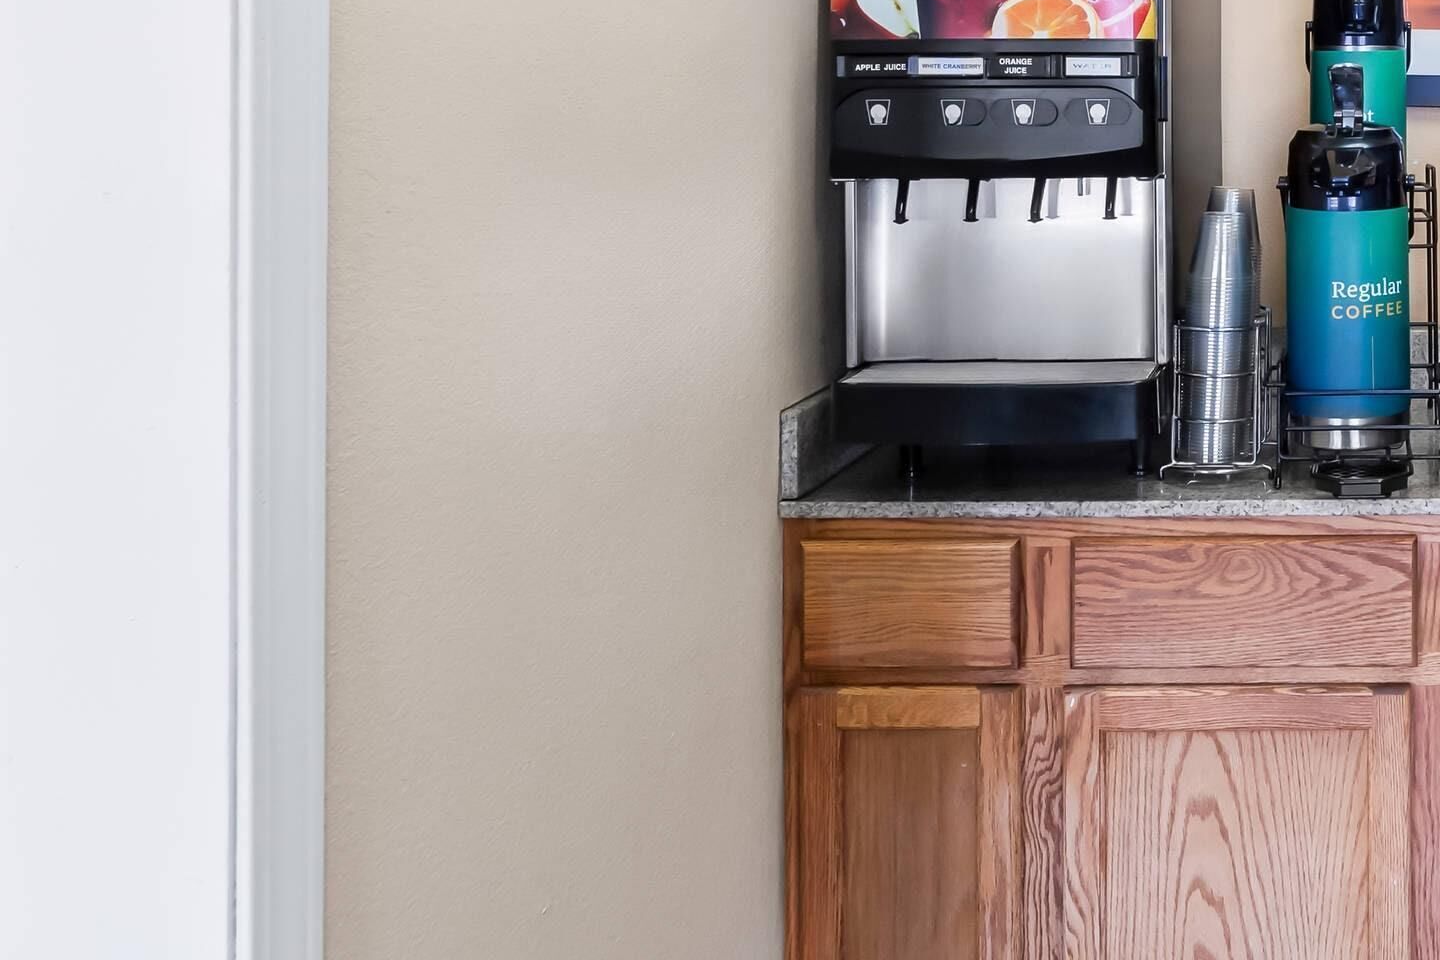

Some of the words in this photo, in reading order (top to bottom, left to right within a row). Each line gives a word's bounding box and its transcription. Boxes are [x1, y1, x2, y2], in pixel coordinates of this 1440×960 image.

[999, 57, 1033, 66] ORANGE
[855, 63, 881, 72] APPLE
[883, 63, 907, 71] JUICE
[1004, 66, 1028, 75] JUICE
[1331, 277, 1402, 303] Regular
[1331, 300, 1403, 320] COFFEE
